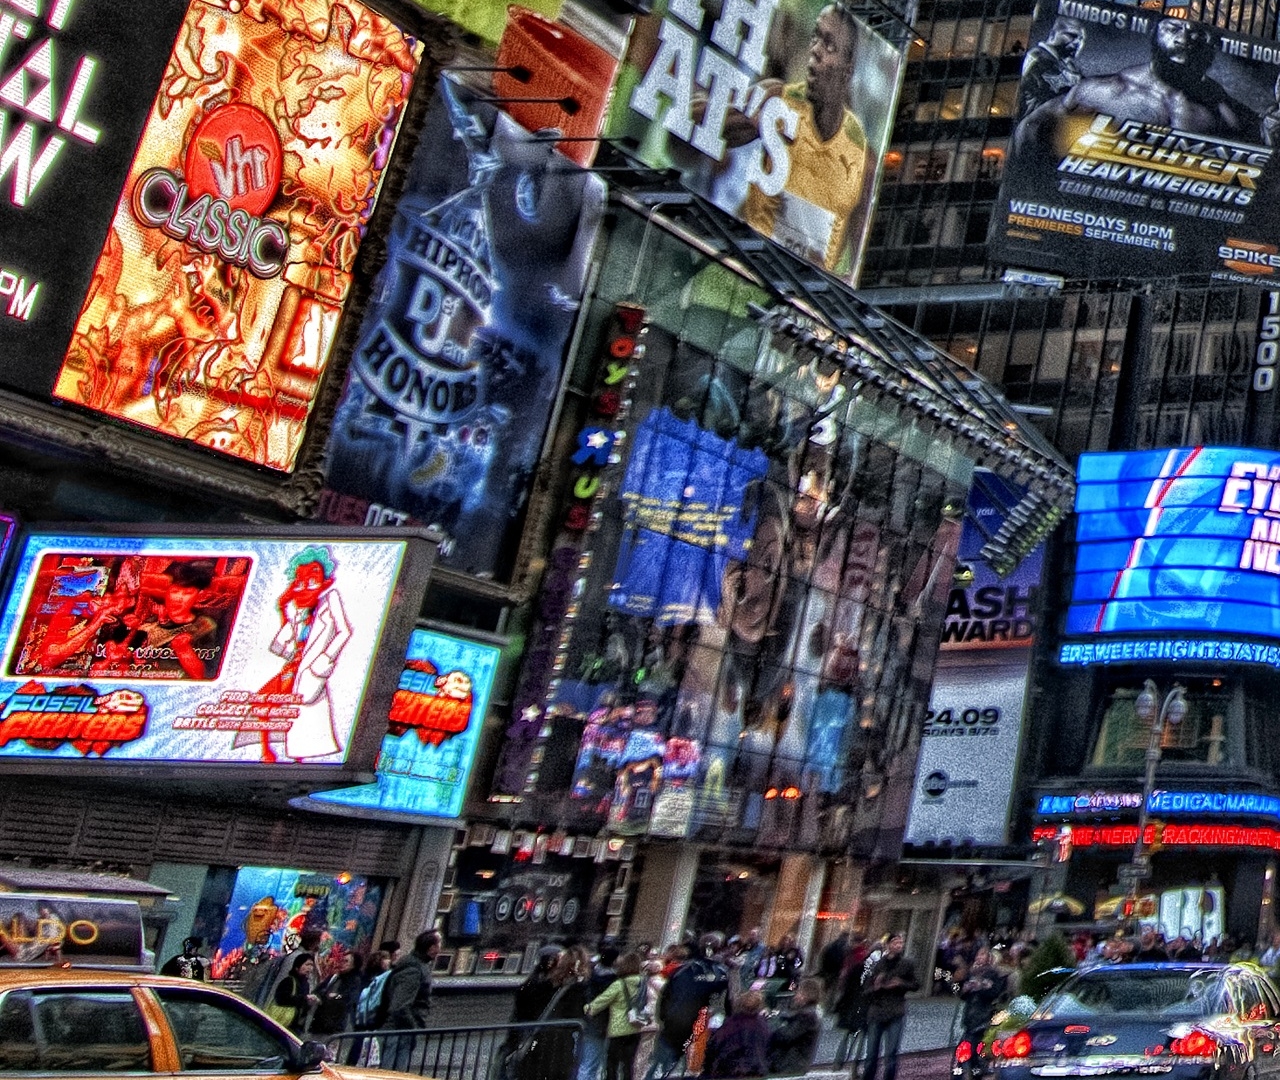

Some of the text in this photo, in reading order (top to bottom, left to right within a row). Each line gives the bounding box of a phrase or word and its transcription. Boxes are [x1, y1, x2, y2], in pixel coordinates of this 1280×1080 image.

[1131, 16, 1148, 33] IN
[1220, 37, 1248, 57] THE
[1089, 113, 1273, 167] ULTIMATE
[1057, 155, 1254, 205] HEAVYWEIGHTS
[1070, 132, 1261, 189] FIGHTER
[1009, 200, 1173, 240] WEDNESDAYS 10PM
[1059, 180, 1090, 197] TEAM
[1092, 183, 1147, 207] RAMPAGE
[1168, 200, 1199, 218] TEAM
[1200, 206, 1245, 223] RASHAD
[134, 169, 289, 278] CLASSIC
[1007, 214, 1175, 252] PREMIERES SEPTEMBER 16
[1254, 291, 1280, 392] 1500
[975, 507, 994, 517] you
[947, 585, 1034, 619] ASH
[939, 619, 1034, 643] WARD
[8, 693, 98, 718] FOSSIL
[10, 918, 98, 946] LDO
